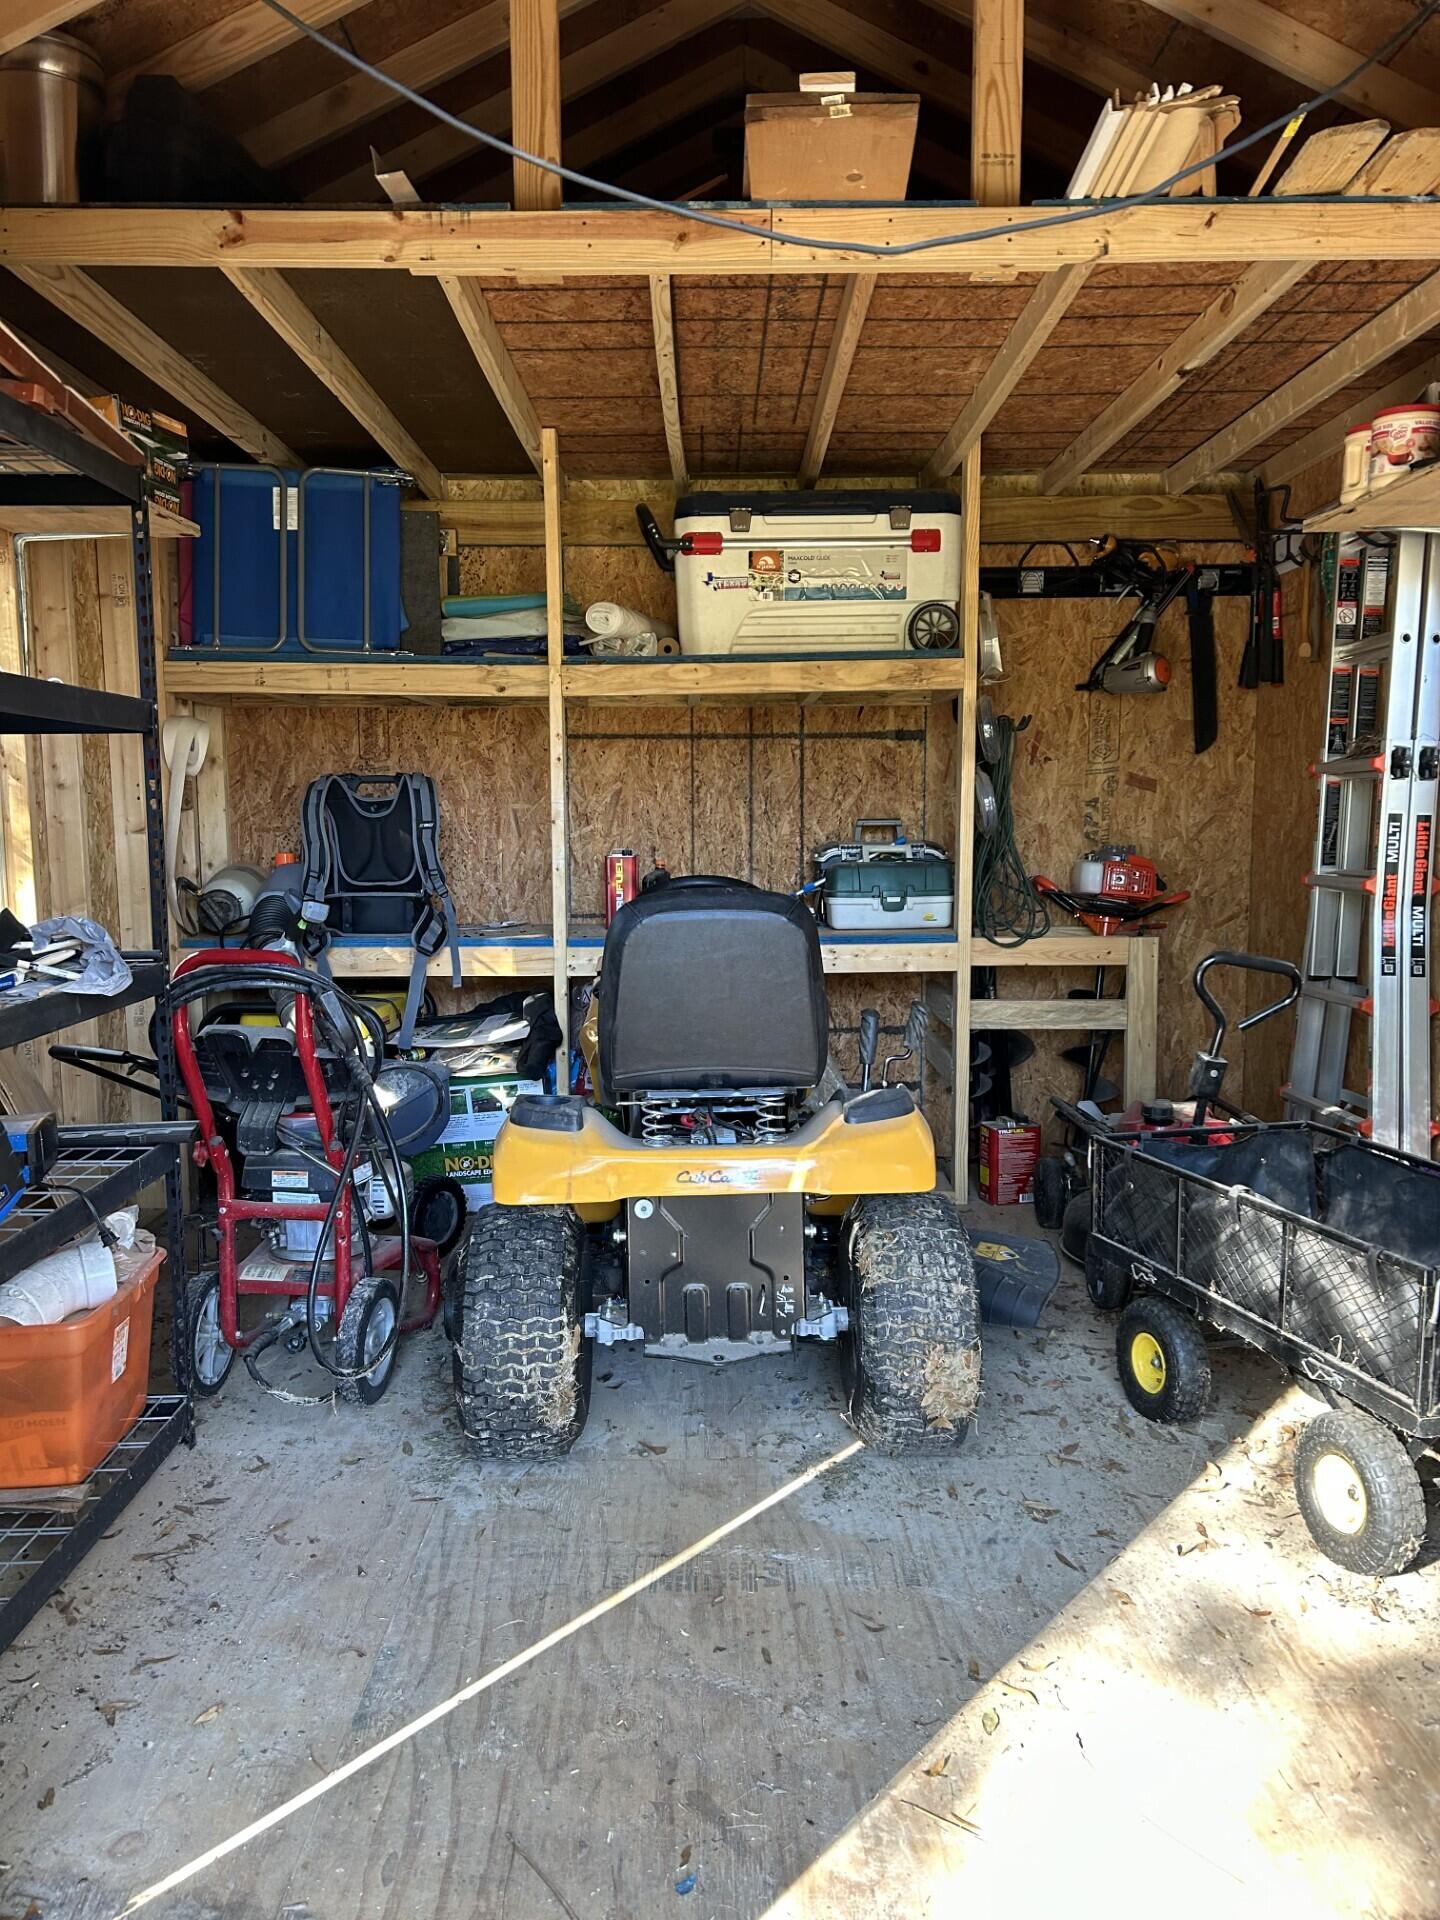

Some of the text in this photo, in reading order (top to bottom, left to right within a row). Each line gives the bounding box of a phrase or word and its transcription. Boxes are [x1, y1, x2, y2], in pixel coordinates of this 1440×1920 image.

[1386, 822, 1401, 863] MULTI
[616, 859, 624, 911] RUFUEL
[1412, 905, 1425, 947] MULTI
[676, 1170, 707, 1184] Cub
